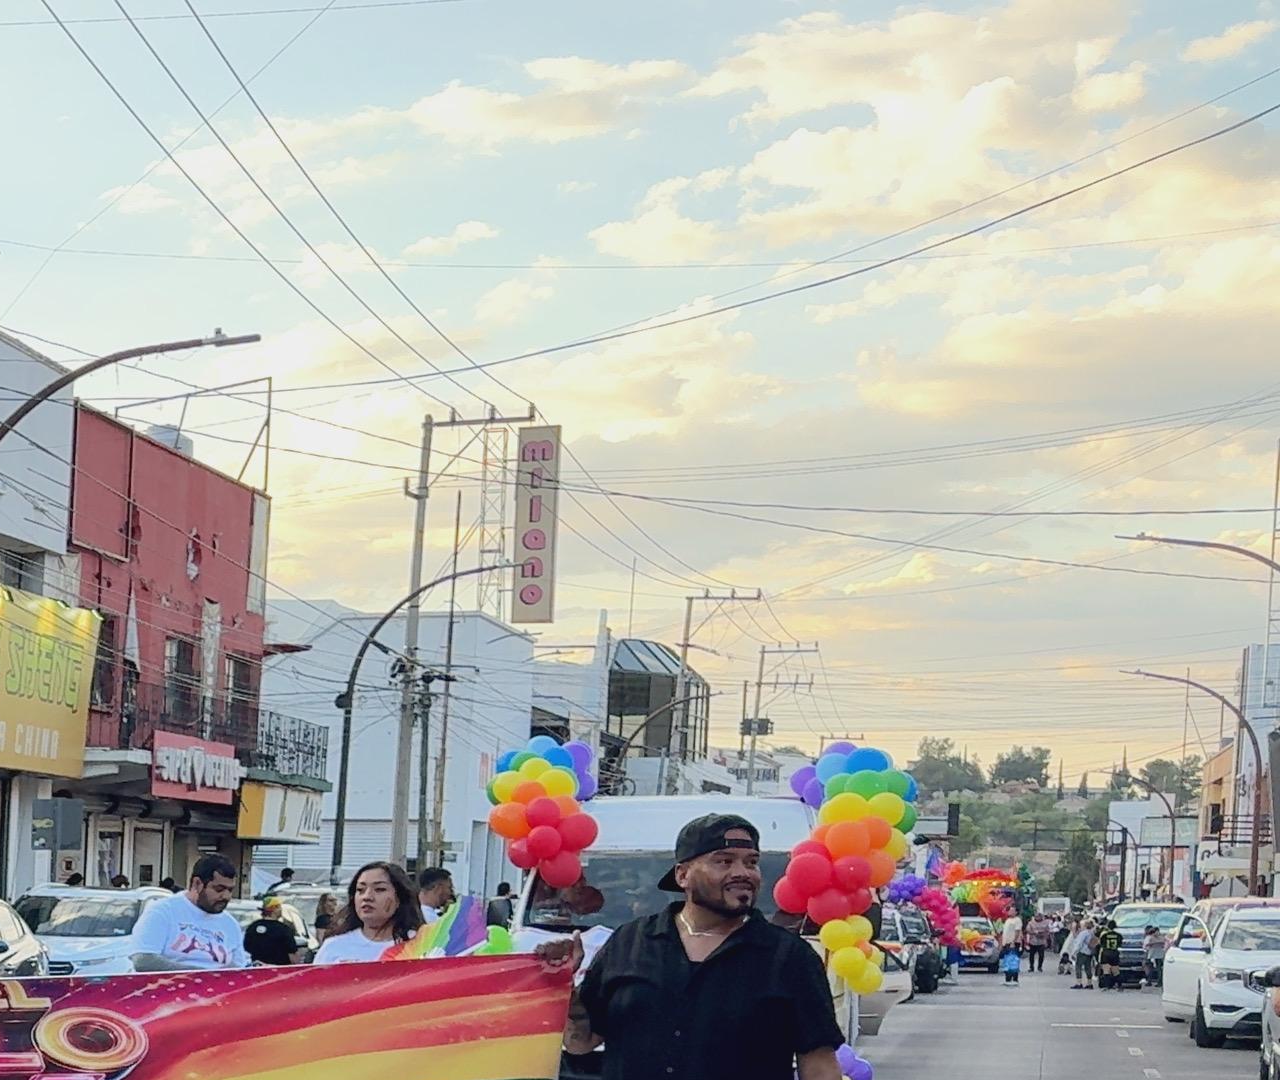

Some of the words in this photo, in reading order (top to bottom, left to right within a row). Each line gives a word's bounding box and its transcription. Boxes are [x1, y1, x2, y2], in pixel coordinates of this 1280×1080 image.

[519, 440, 554, 605] milano
[5, 625, 85, 714] SHENG
[14, 722, 60, 761] CHINA
